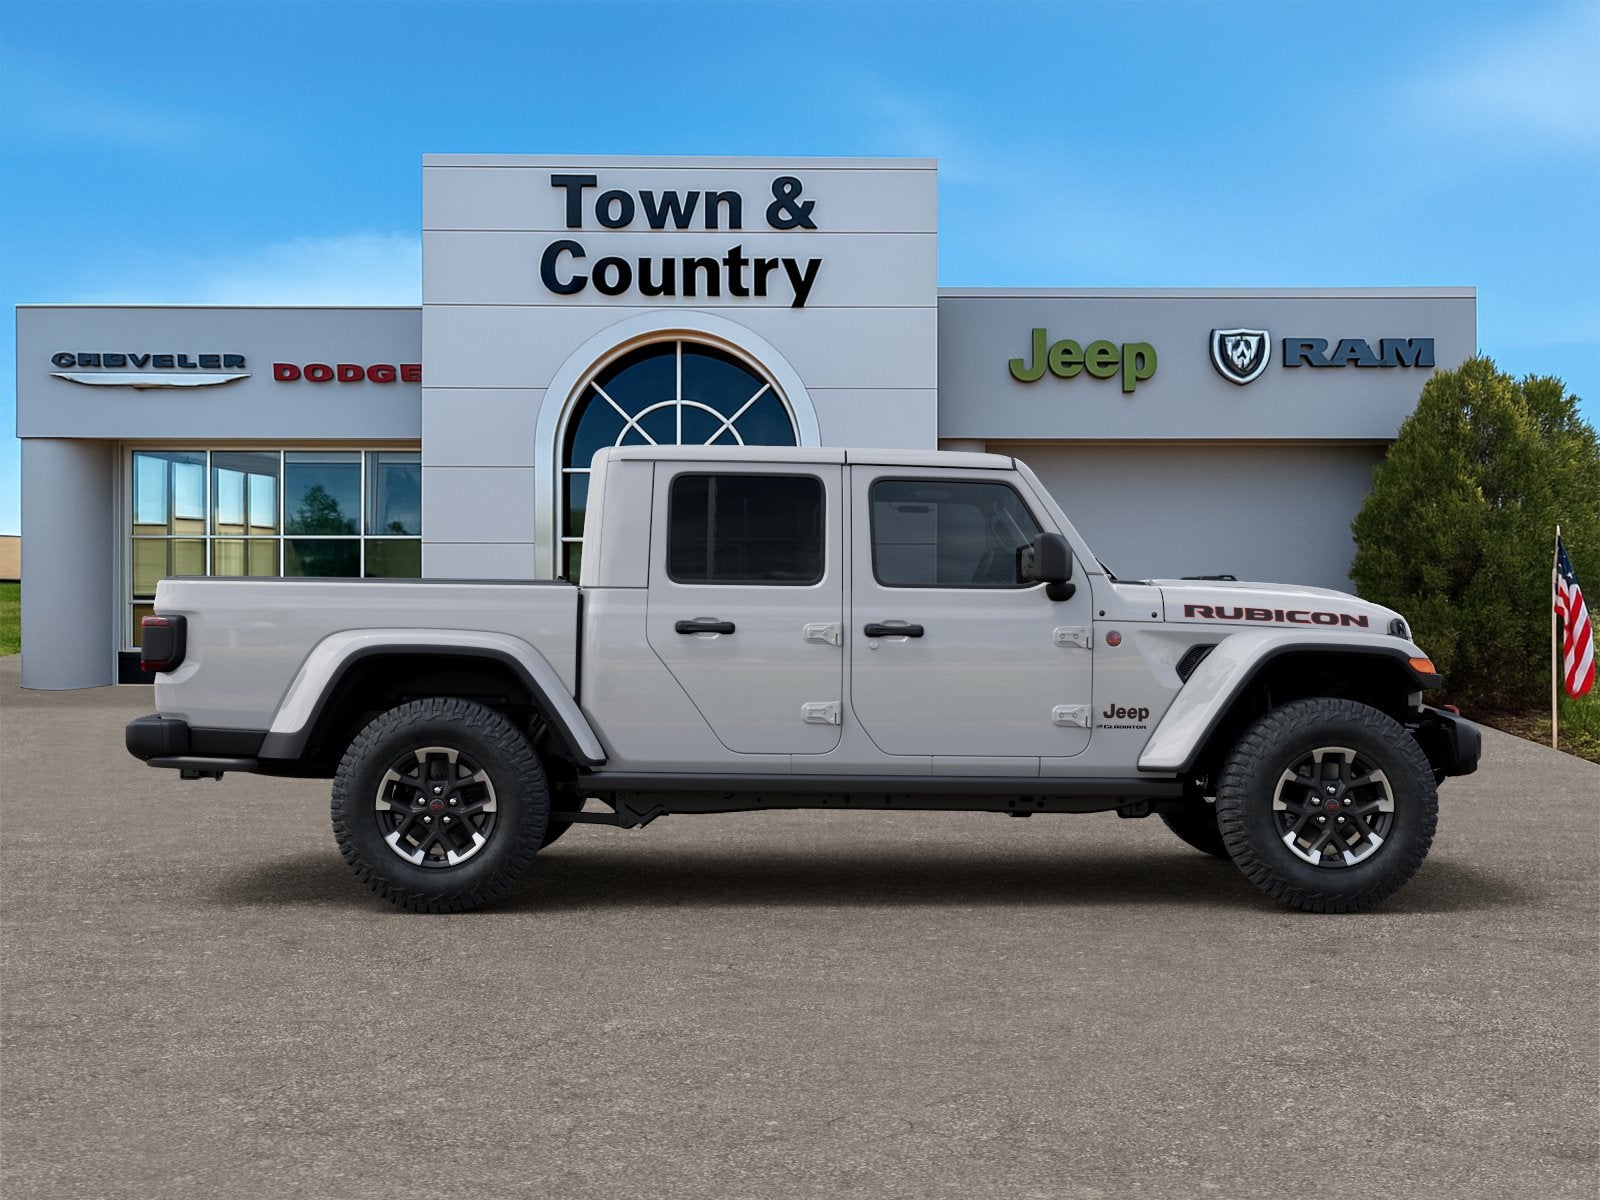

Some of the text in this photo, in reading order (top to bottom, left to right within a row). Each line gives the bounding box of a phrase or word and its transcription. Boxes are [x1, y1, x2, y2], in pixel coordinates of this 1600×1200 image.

[550, 173, 818, 230] Town &
[539, 239, 822, 308] Country
[1009, 328, 1157, 392] Jeep
[1283, 338, 1435, 368] RAM
[273, 363, 422, 383] DODGE
[1184, 604, 1369, 628] RUBICON
[1103, 704, 1150, 722] Jeep
